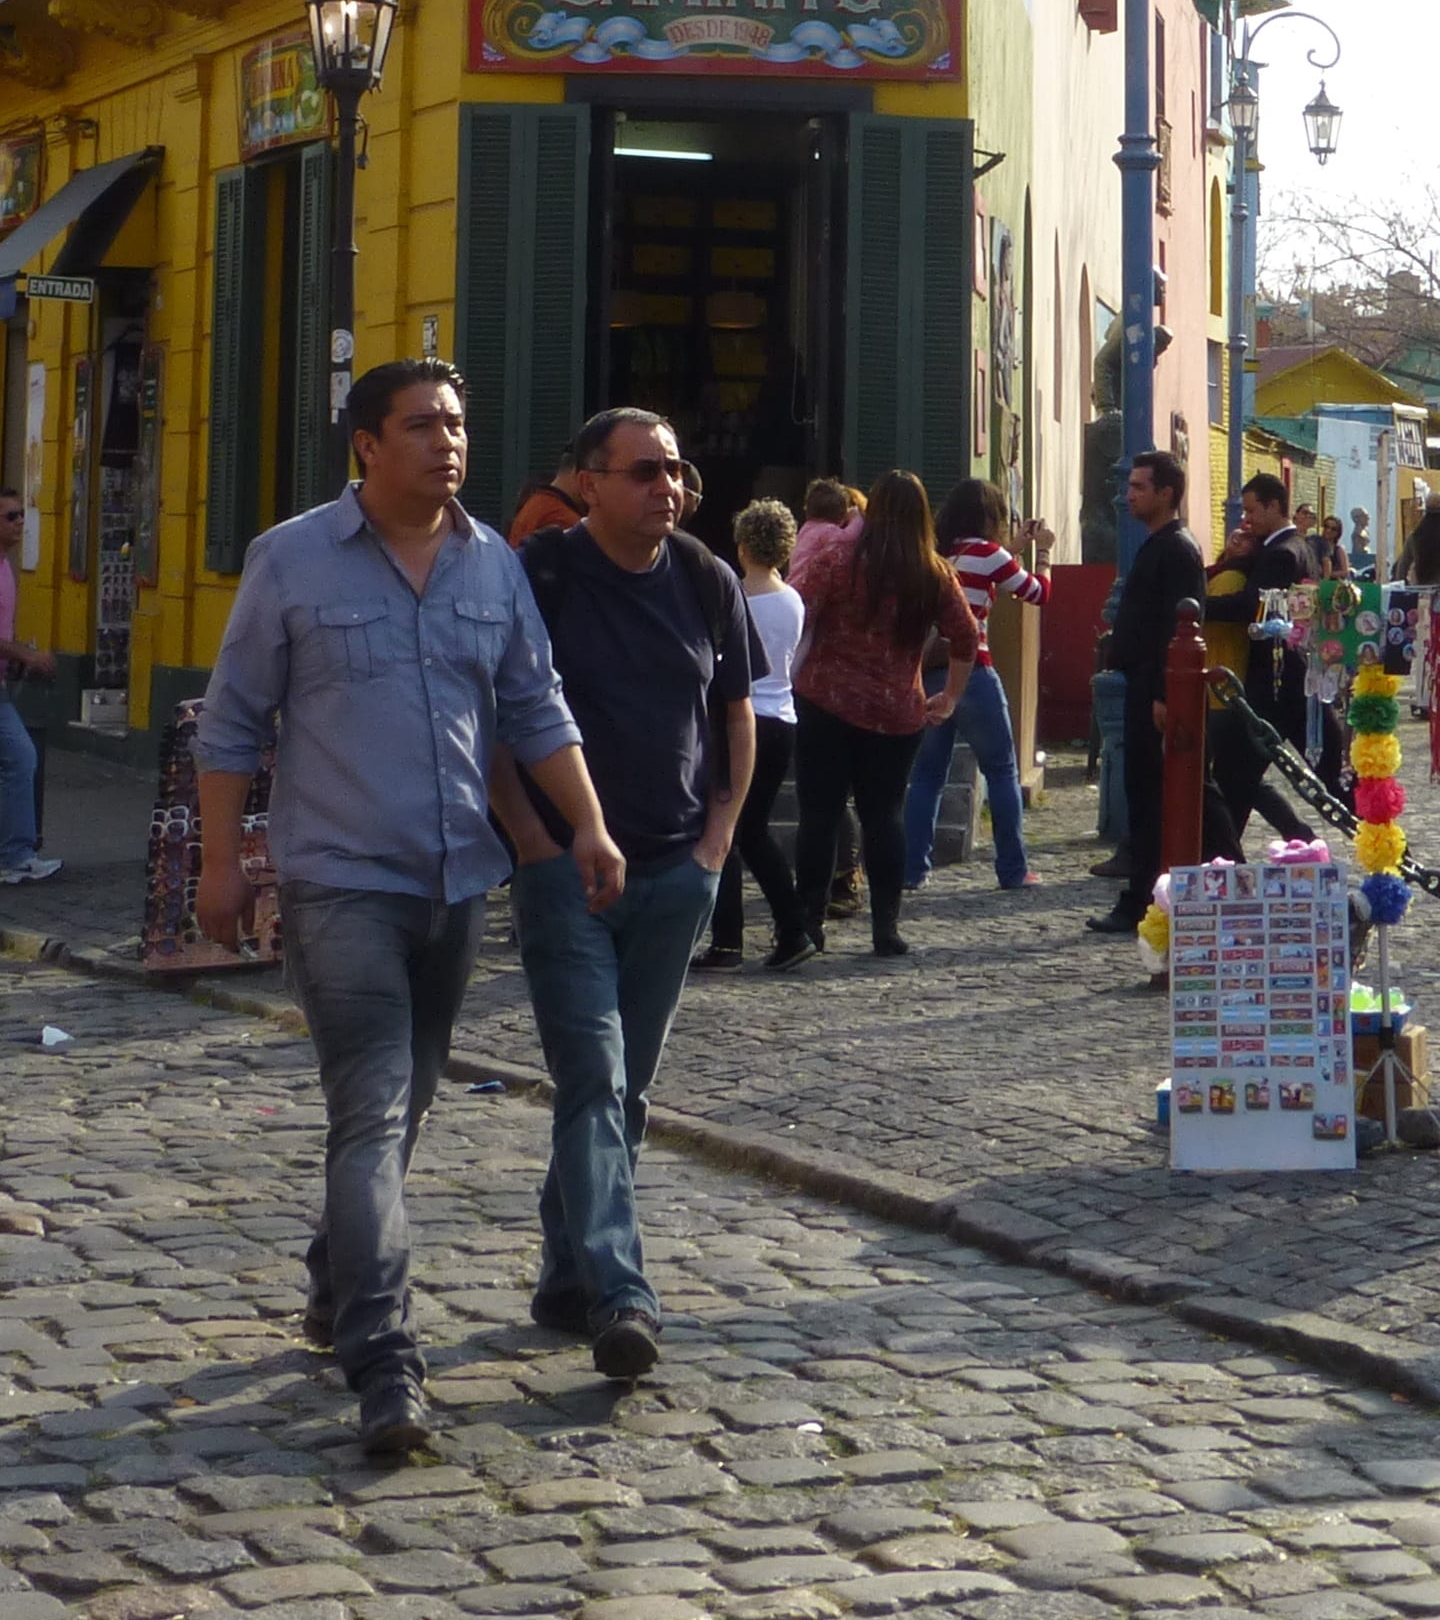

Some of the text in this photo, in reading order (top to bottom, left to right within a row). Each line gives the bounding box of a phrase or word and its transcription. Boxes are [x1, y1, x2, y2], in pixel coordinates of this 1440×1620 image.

[669, 18, 771, 50] DESDE 1948
[29, 278, 90, 298] ENTRADA
